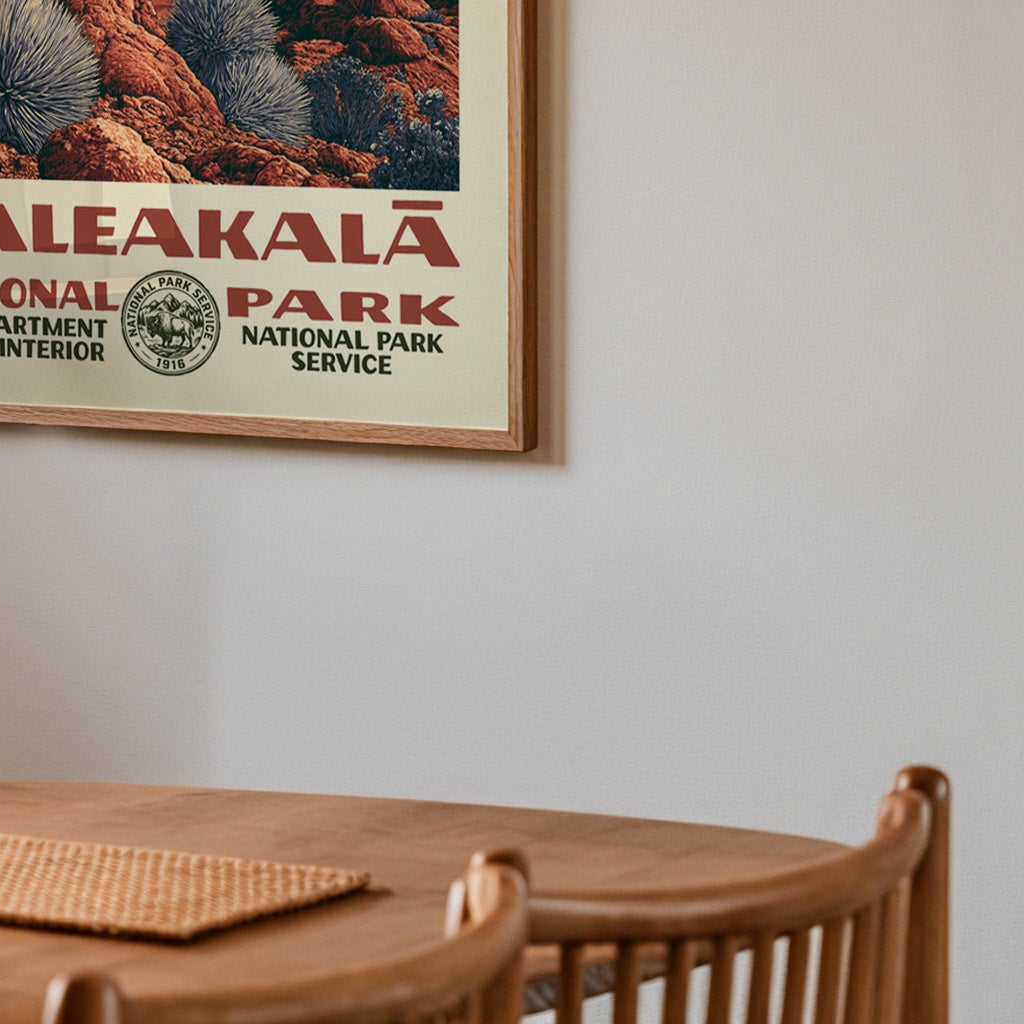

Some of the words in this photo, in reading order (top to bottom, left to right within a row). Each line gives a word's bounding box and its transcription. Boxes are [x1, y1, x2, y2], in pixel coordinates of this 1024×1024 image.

[127, 282, 156, 338] NATIONAL
[158, 276, 192, 292] PARK
[192, 288, 215, 341] SERVICE
[226, 287, 460, 327] PARK
[0, 338, 105, 361] INTERIOR
[242, 325, 369, 350] NATIONAL
[377, 331, 444, 353] PARK
[156, 357, 186, 370] 1916
[291, 351, 393, 375] SERVICE
